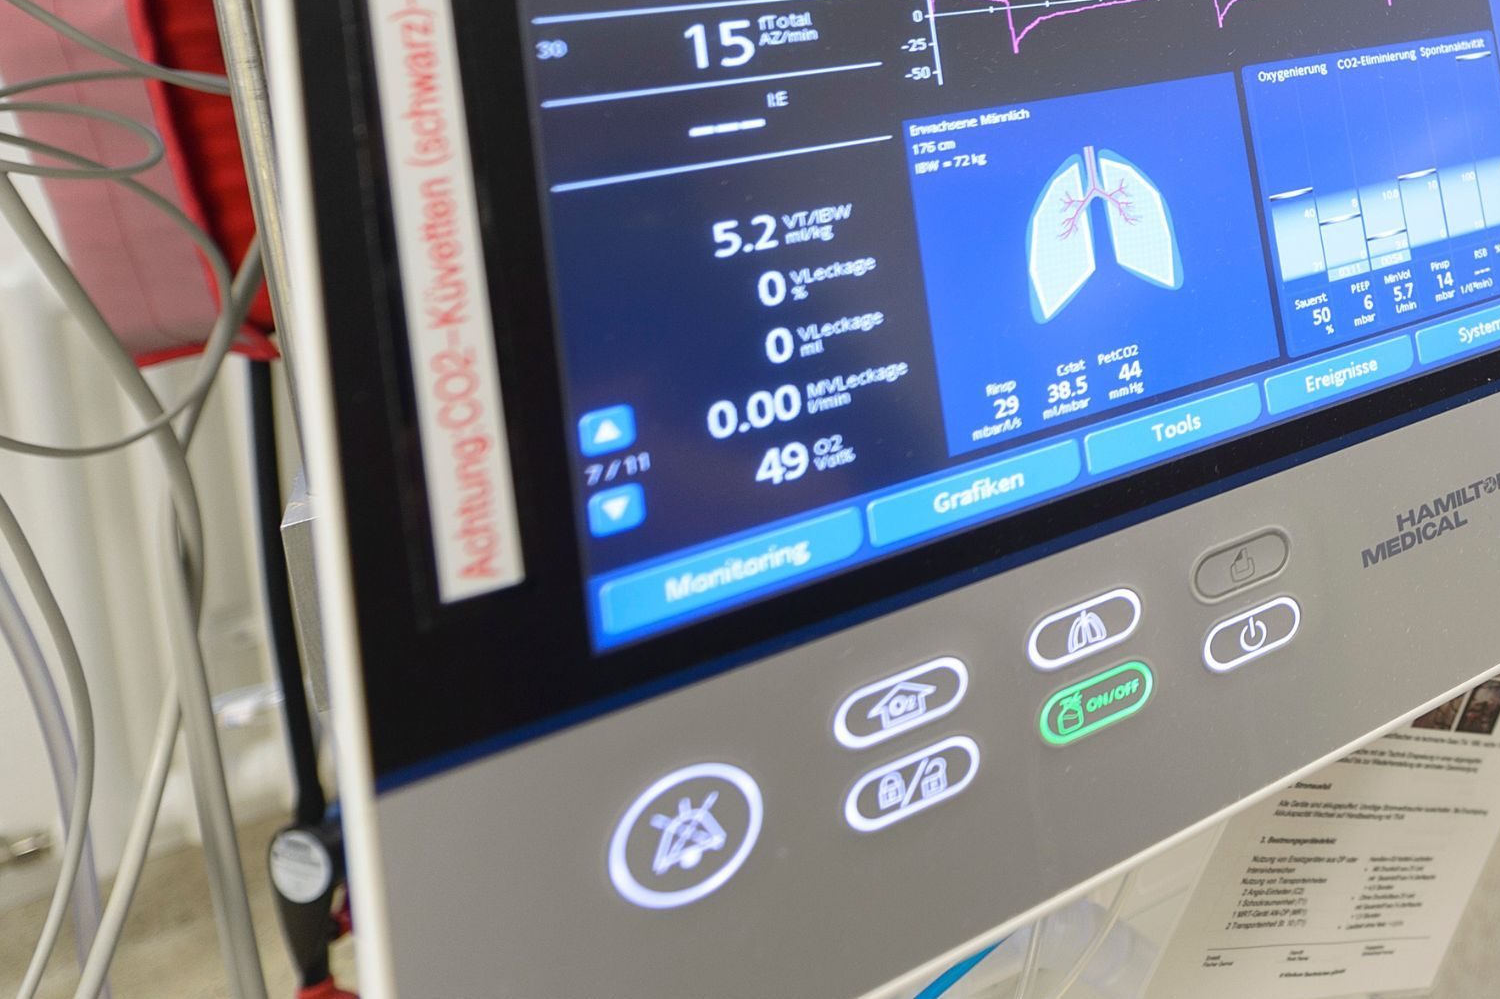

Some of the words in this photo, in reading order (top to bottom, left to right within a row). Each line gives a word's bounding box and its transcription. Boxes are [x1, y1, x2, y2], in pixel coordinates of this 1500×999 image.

[758, 12, 813, 30] fTotal
[912, 10, 923, 22] 0
[684, 20, 756, 70] 15
[759, 28, 819, 47] AZ/min
[901, 39, 927, 51] -25
[535, 40, 568, 60] 30
[1258, 62, 1328, 82] Oxygenierung
[1337, 48, 1416, 71] CO2-Eliminierung
[1420, 38, 1485, 58] Spontanaktivität
[904, 67, 931, 80] -50
[909, 117, 978, 137] Erwachsene
[980, 108, 1030, 126] Männlich
[912, 140, 937, 155] 176
[937, 140, 957, 152] cm
[953, 154, 970, 168] 72
[971, 153, 988, 166] kg
[1304, 208, 1316, 219] 40
[711, 213, 779, 258] 5.2
[1473, 248, 1488, 259] RSB
[789, 254, 876, 286] VLeckage
[1430, 260, 1450, 272] Pinsp
[1351, 279, 1370, 293] PEEP
[1384, 269, 1412, 285] MinVol
[1437, 271, 1454, 289] 14
[757, 270, 788, 307] 0
[791, 285, 809, 301] %
[1393, 283, 1413, 301] 5.7
[1435, 289, 1456, 302] mbar
[1295, 292, 1328, 310] Sauerst
[1363, 294, 1373, 310] 6
[1395, 300, 1417, 315] l/min
[797, 309, 885, 342] VLeckage
[1312, 306, 1331, 325] 50
[1354, 313, 1376, 327] mbar
[765, 325, 795, 365] 0
[799, 338, 824, 358] ml
[1097, 344, 1139, 366] PetCO2
[1056, 358, 1087, 378] Cstat
[1118, 360, 1143, 382] 44
[1305, 355, 1378, 394] Ereignisse
[807, 360, 908, 398] MVLeckage
[1047, 376, 1089, 403] 38.5
[1108, 382, 1144, 400] mmHg
[707, 383, 802, 439] 0.00
[993, 395, 1020, 420] 29
[1042, 396, 1091, 421] ml/mbar
[1151, 412, 1202, 443] Tools
[814, 433, 844, 458] O2
[755, 440, 810, 485] 49
[814, 447, 857, 470] Vol%
[932, 469, 1025, 514] Grafiken
[1361, 510, 1469, 568] MEDICAL
[664, 540, 810, 602] Monitoring
[888, 693, 918, 717] O2
[1085, 678, 1140, 714] ON/OFF
